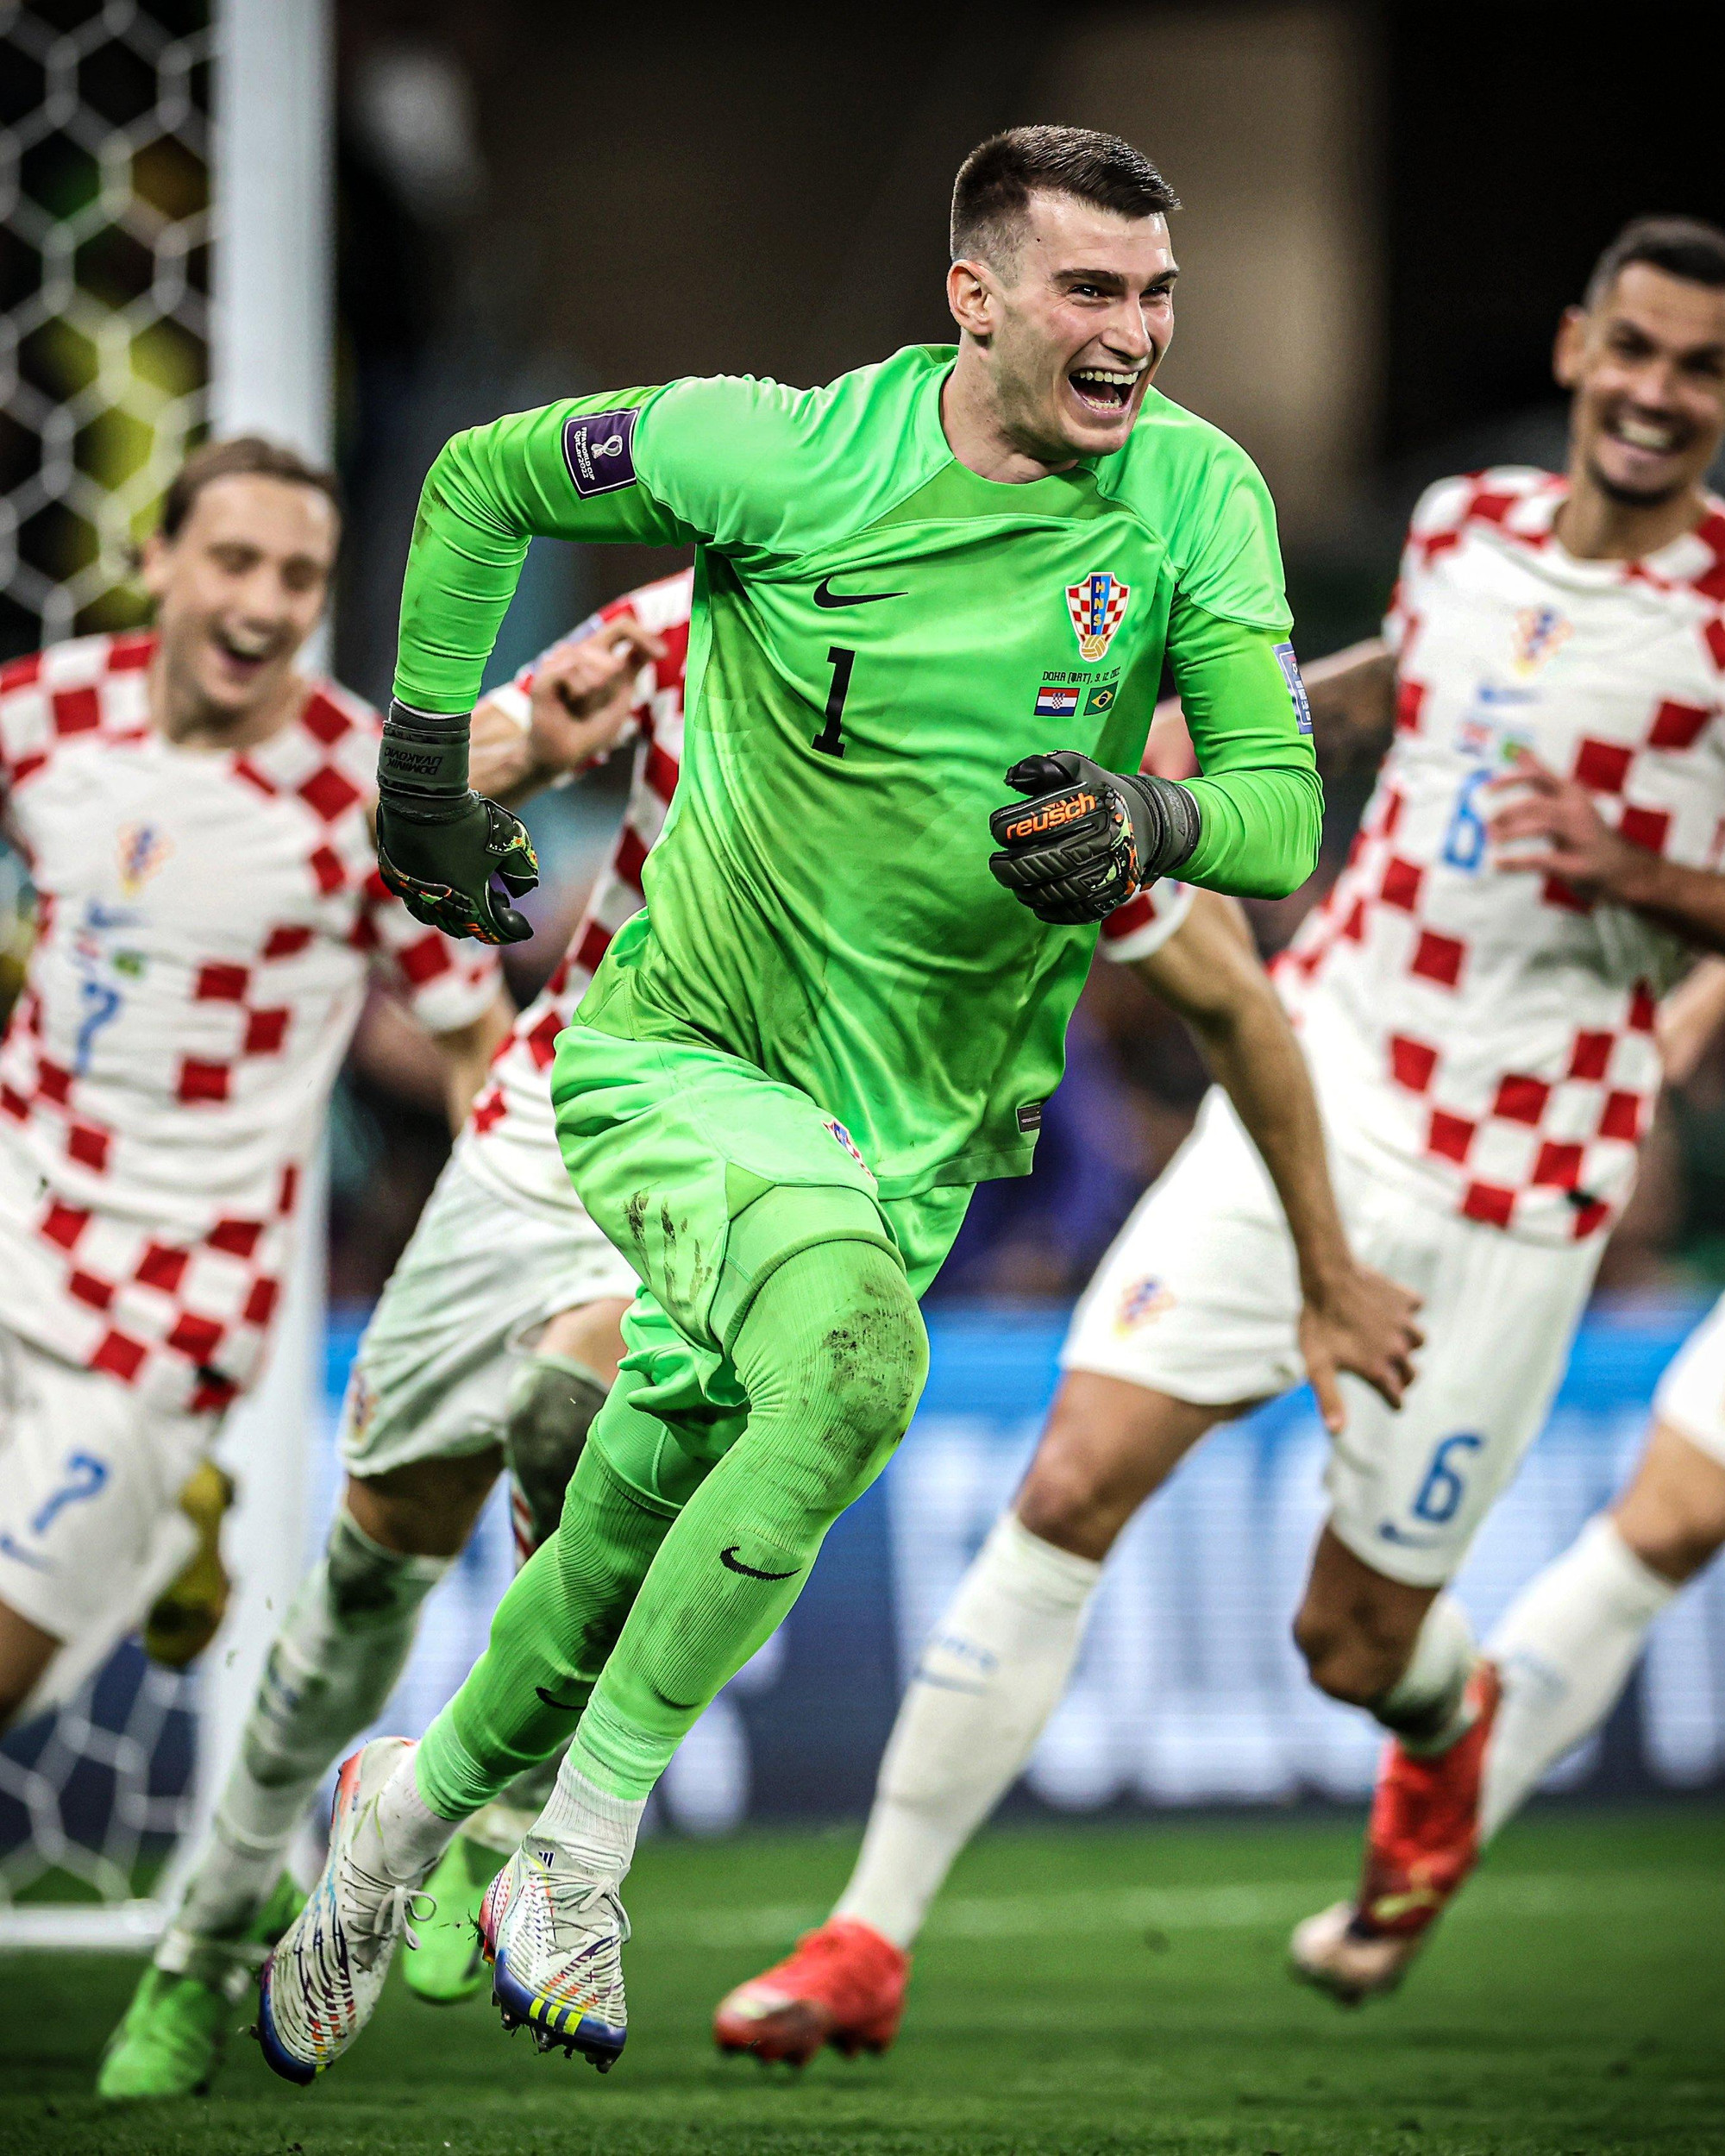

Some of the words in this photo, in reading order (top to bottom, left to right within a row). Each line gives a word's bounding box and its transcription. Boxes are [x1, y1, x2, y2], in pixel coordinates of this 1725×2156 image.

[581, 441, 592, 467] WORLD
[1093, 581, 1106, 626] HNS
[811, 645, 856, 759] 1
[1042, 670, 1066, 681] DOHA
[1006, 792, 1096, 839] reusch
[72, 982, 120, 1078] 7
[31, 1451, 108, 1534] 7
[1413, 1433, 1483, 1524] 6
